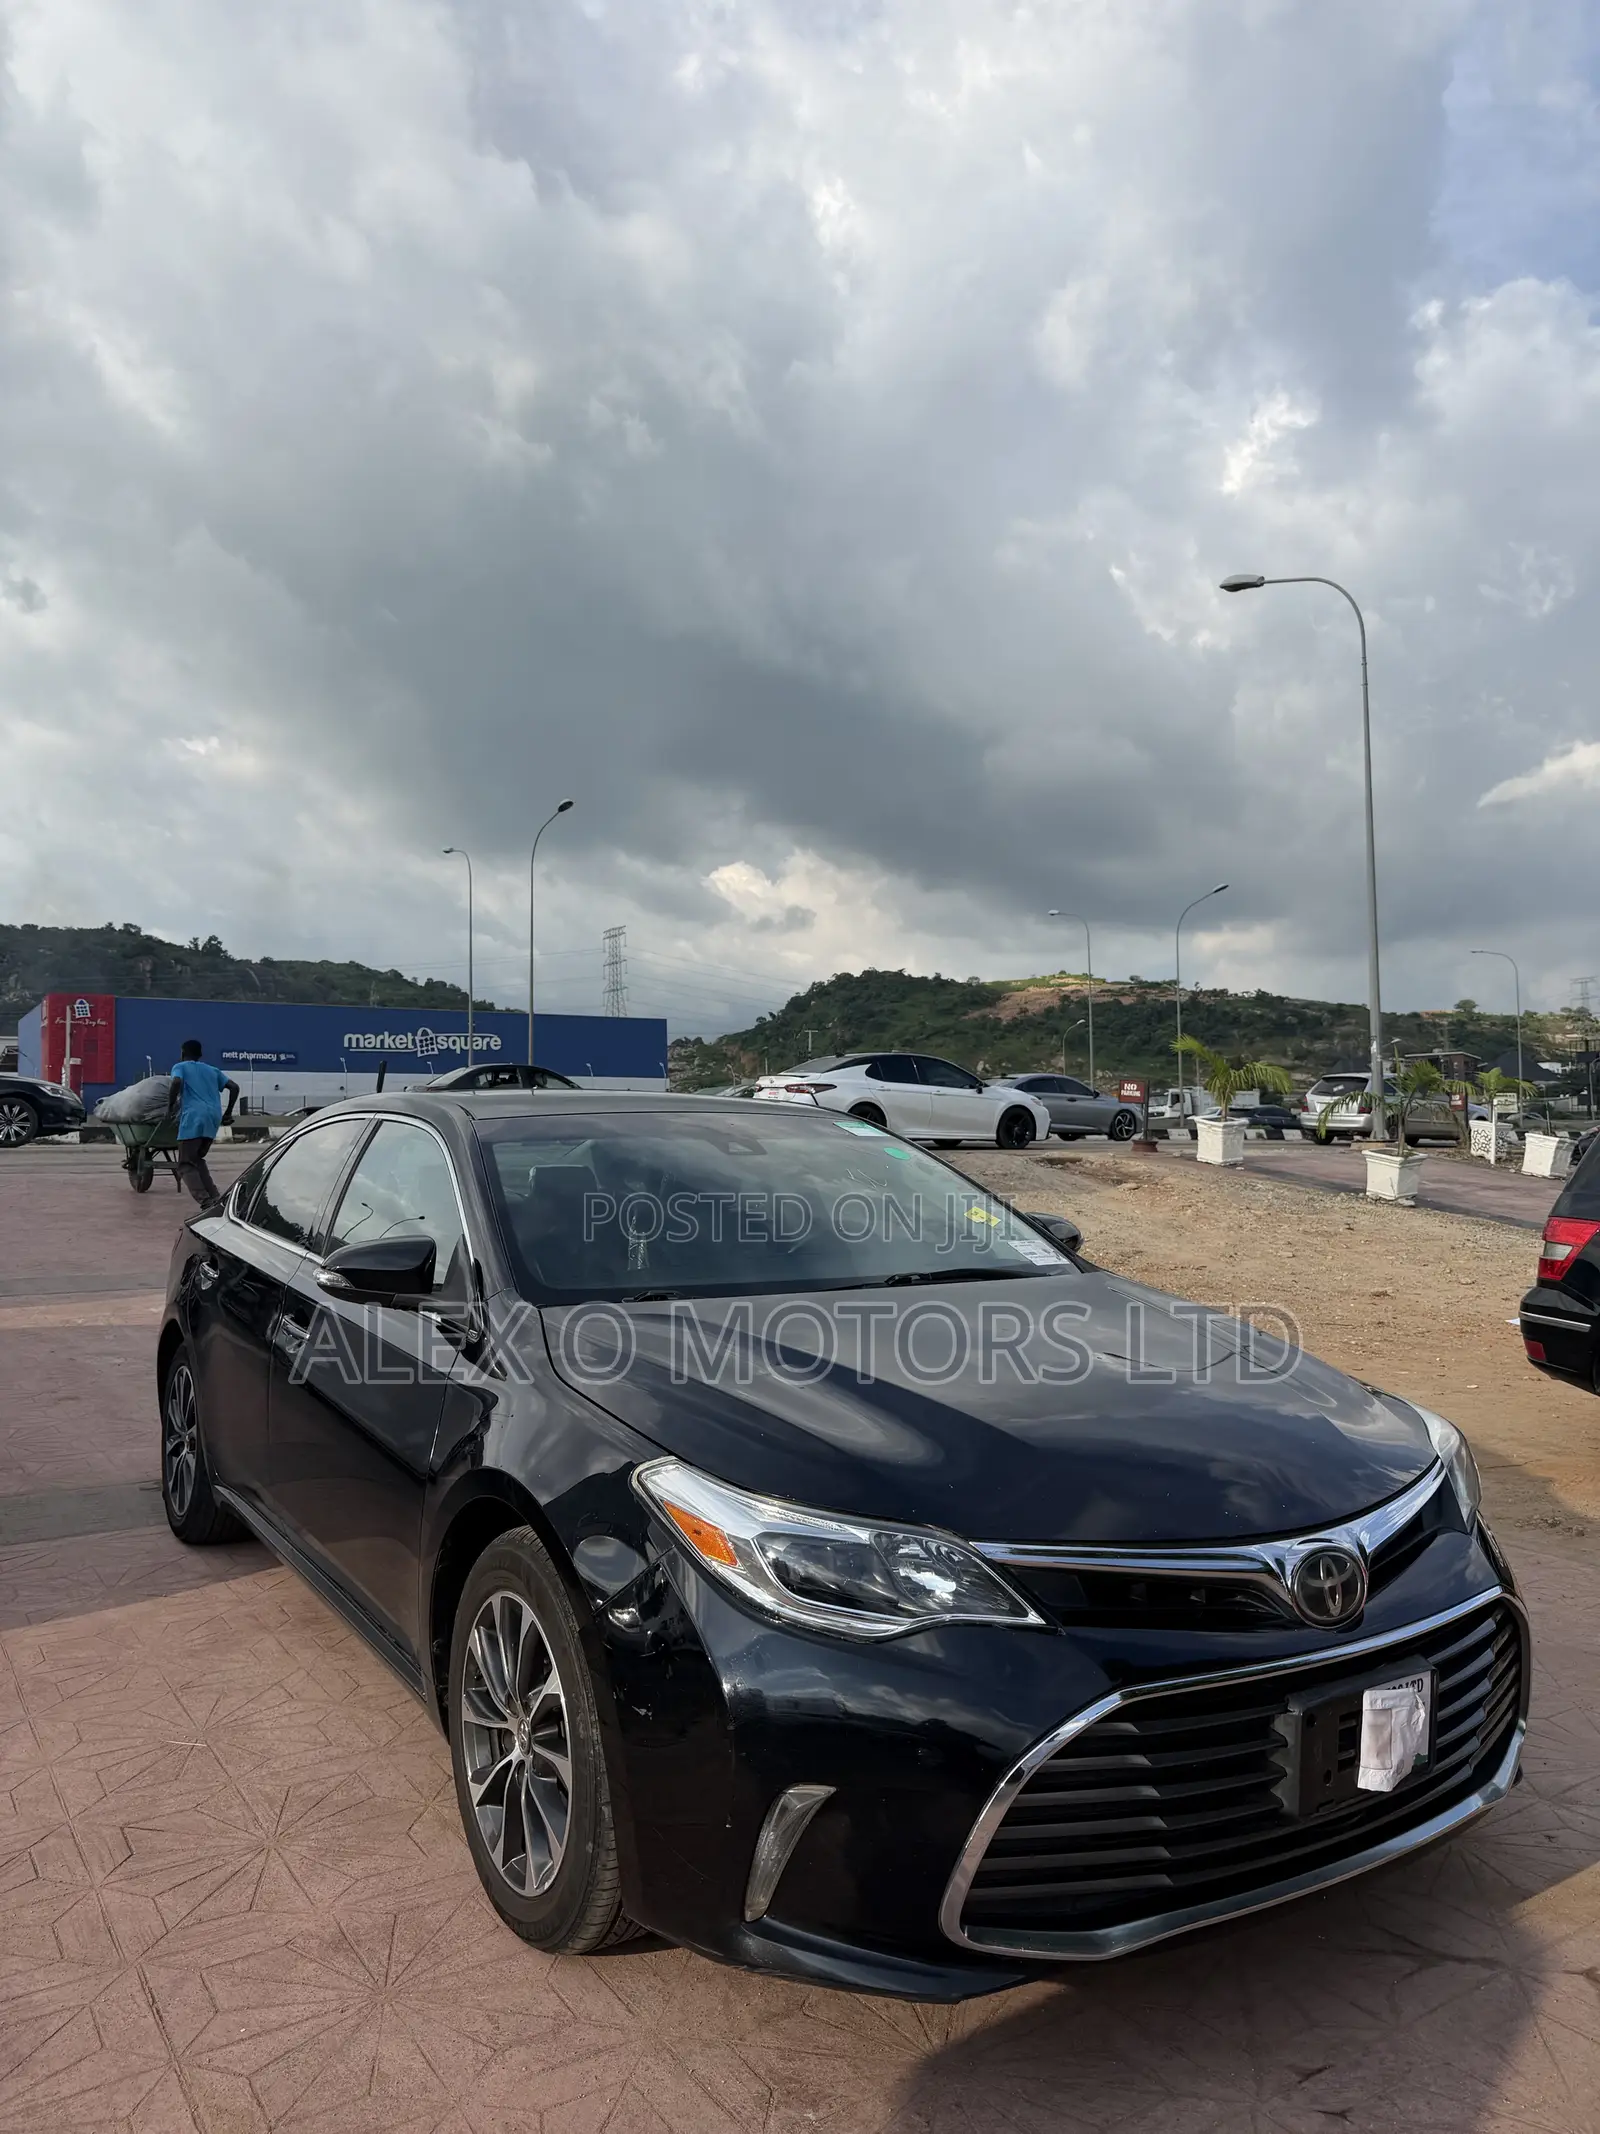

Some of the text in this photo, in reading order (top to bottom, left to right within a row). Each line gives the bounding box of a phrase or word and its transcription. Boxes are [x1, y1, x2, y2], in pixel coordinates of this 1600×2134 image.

[343, 1031, 502, 1054] market square
[239, 1051, 277, 1061] pharmacy
